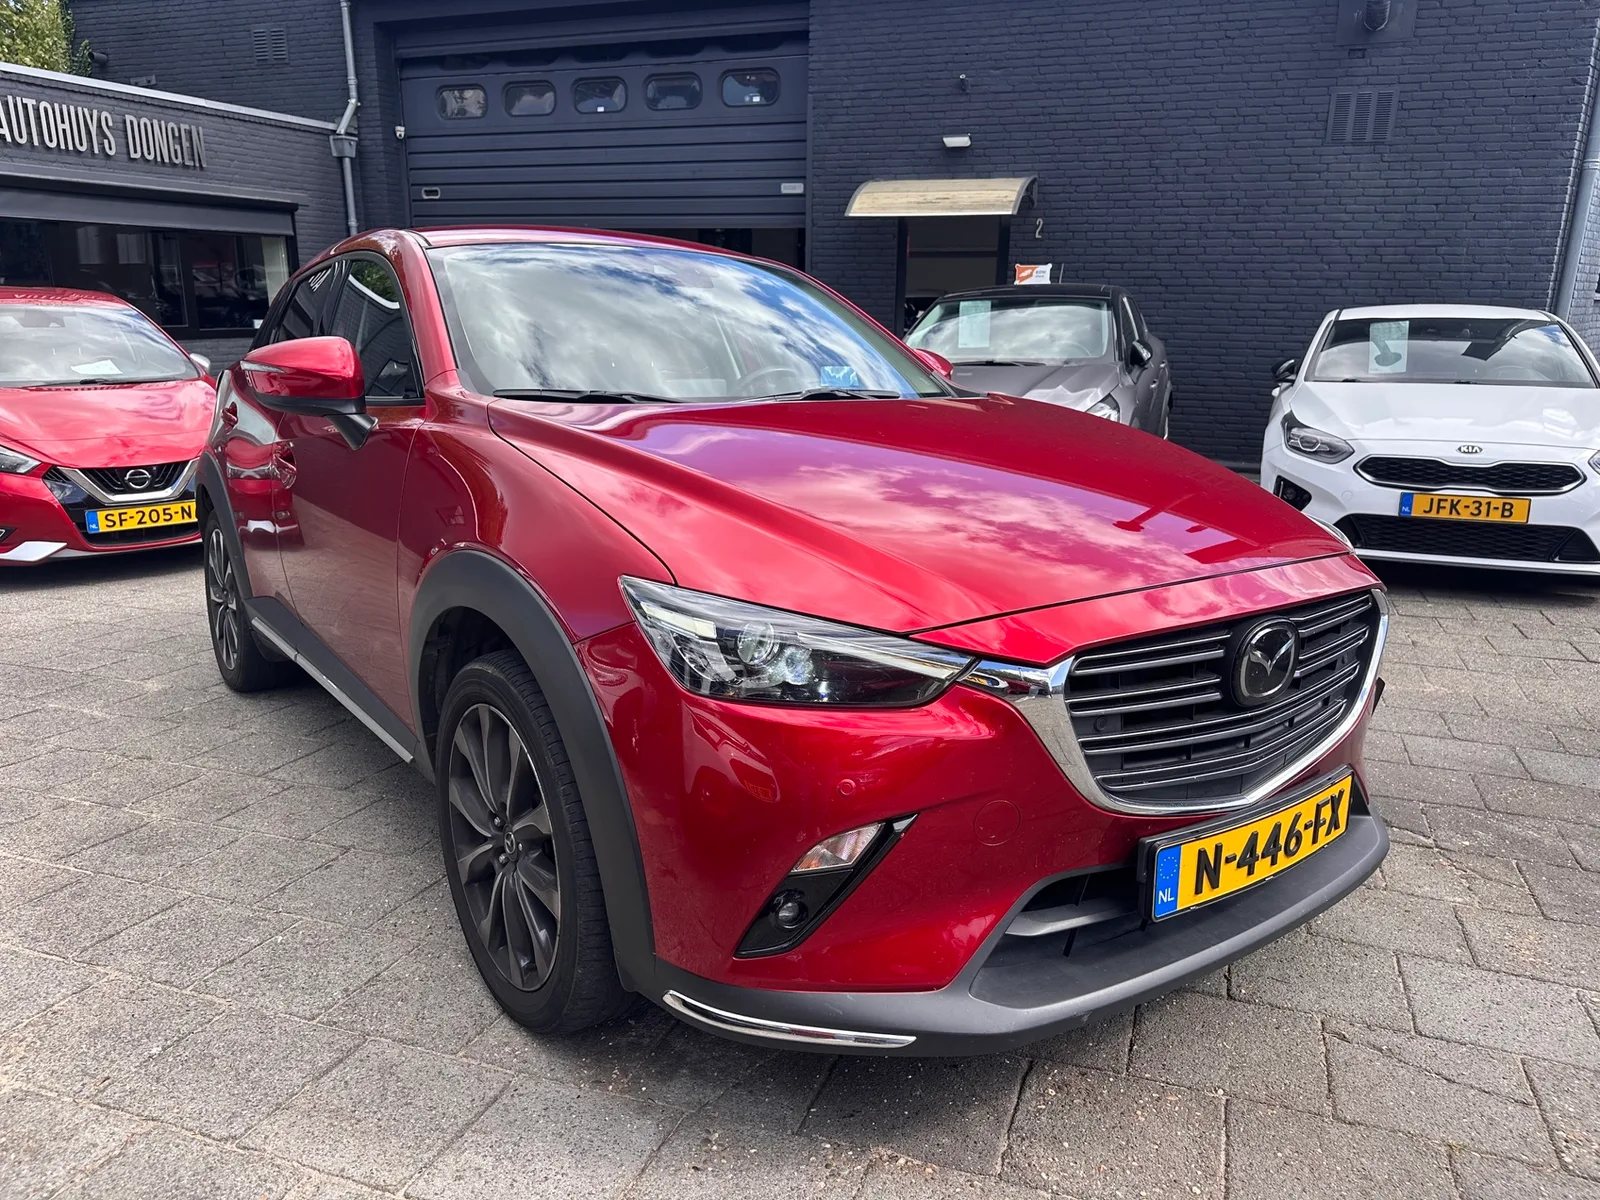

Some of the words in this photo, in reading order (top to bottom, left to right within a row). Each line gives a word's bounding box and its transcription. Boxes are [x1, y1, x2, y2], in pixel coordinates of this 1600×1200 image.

[125, 114, 207, 168] DONGEN
[1035, 218, 1043, 239] 2
[1460, 445, 1480, 454] KIA
[89, 522, 98, 530] NL
[104, 505, 192, 528] SF-205-N
[1423, 497, 1514, 519] JFK-31-B
[1158, 887, 1175, 905] NL
[1194, 788, 1345, 895] N-446-FX
